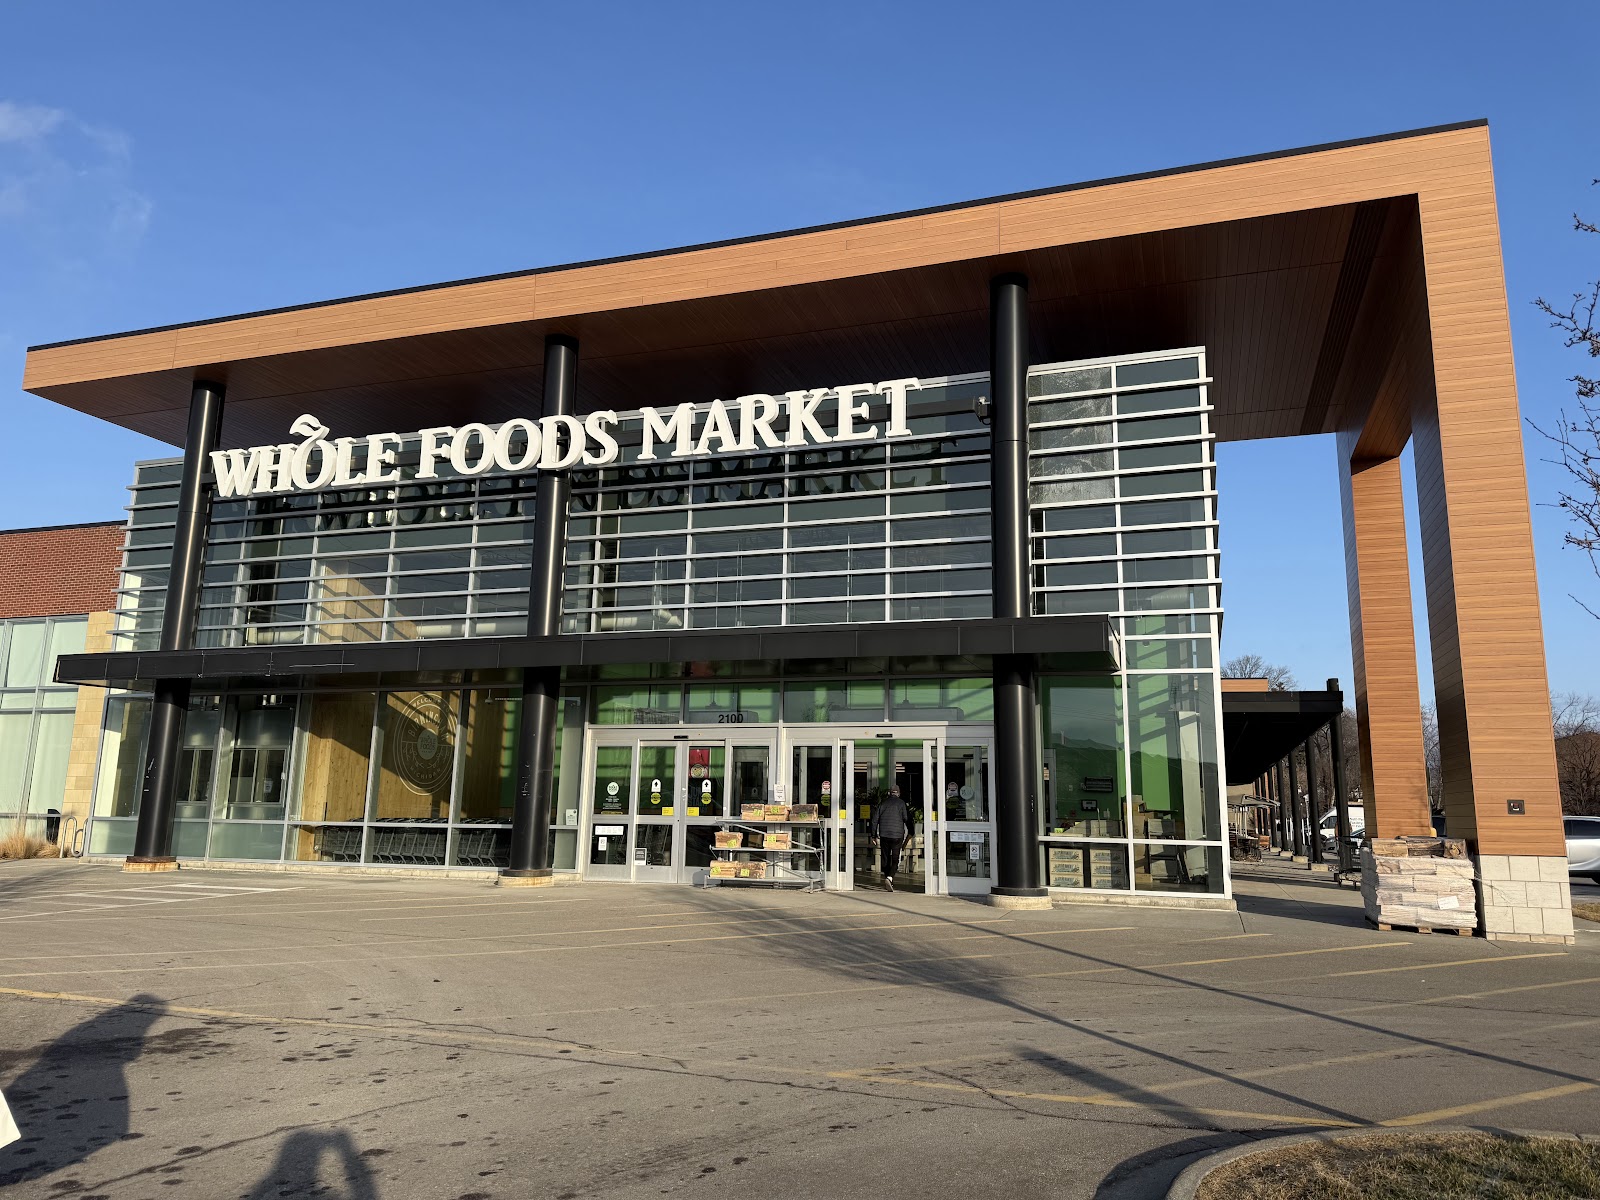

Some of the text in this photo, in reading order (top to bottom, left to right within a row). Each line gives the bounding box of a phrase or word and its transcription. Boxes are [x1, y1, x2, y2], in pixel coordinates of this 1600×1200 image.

[209, 377, 922, 498] WHOLE FOODS MARKET
[718, 713, 744, 724] 2100
